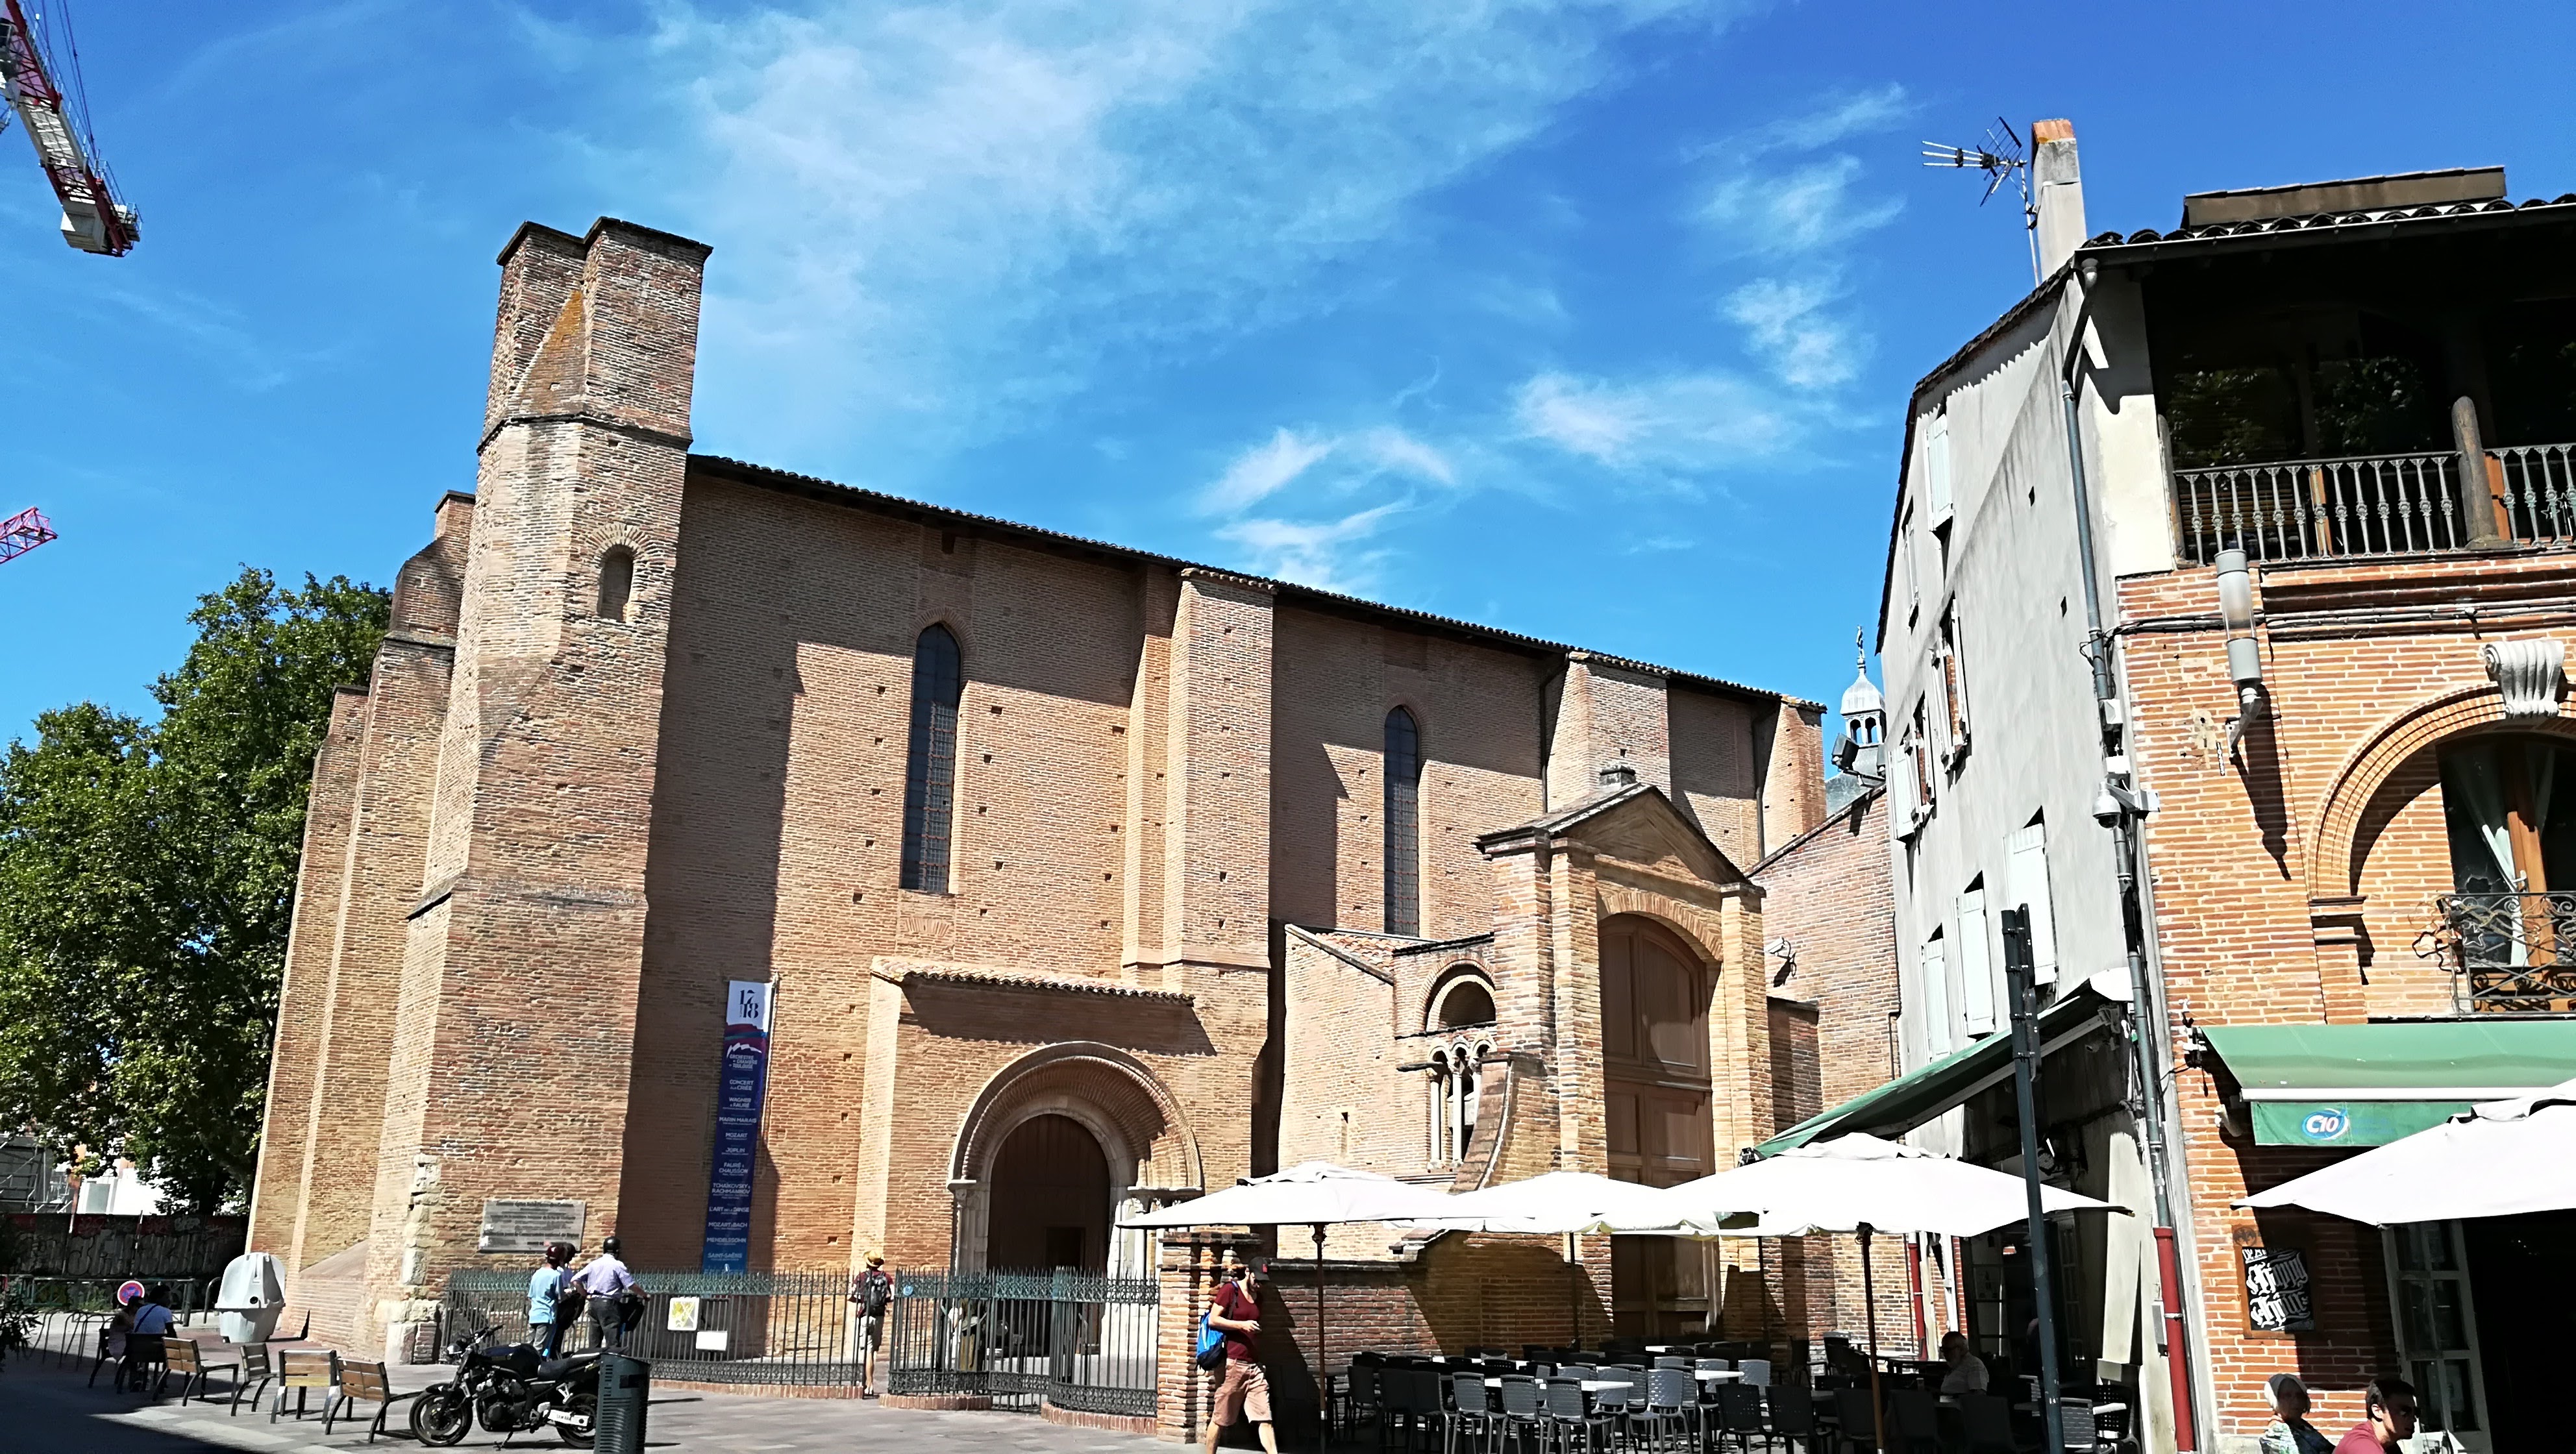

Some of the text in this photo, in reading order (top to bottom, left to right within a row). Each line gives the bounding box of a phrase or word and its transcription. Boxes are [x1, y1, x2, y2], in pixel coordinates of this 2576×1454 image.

[740, 990, 755, 1004] 17
[743, 1004, 758, 1018] 18
[2307, 1115, 2338, 1133] C10
